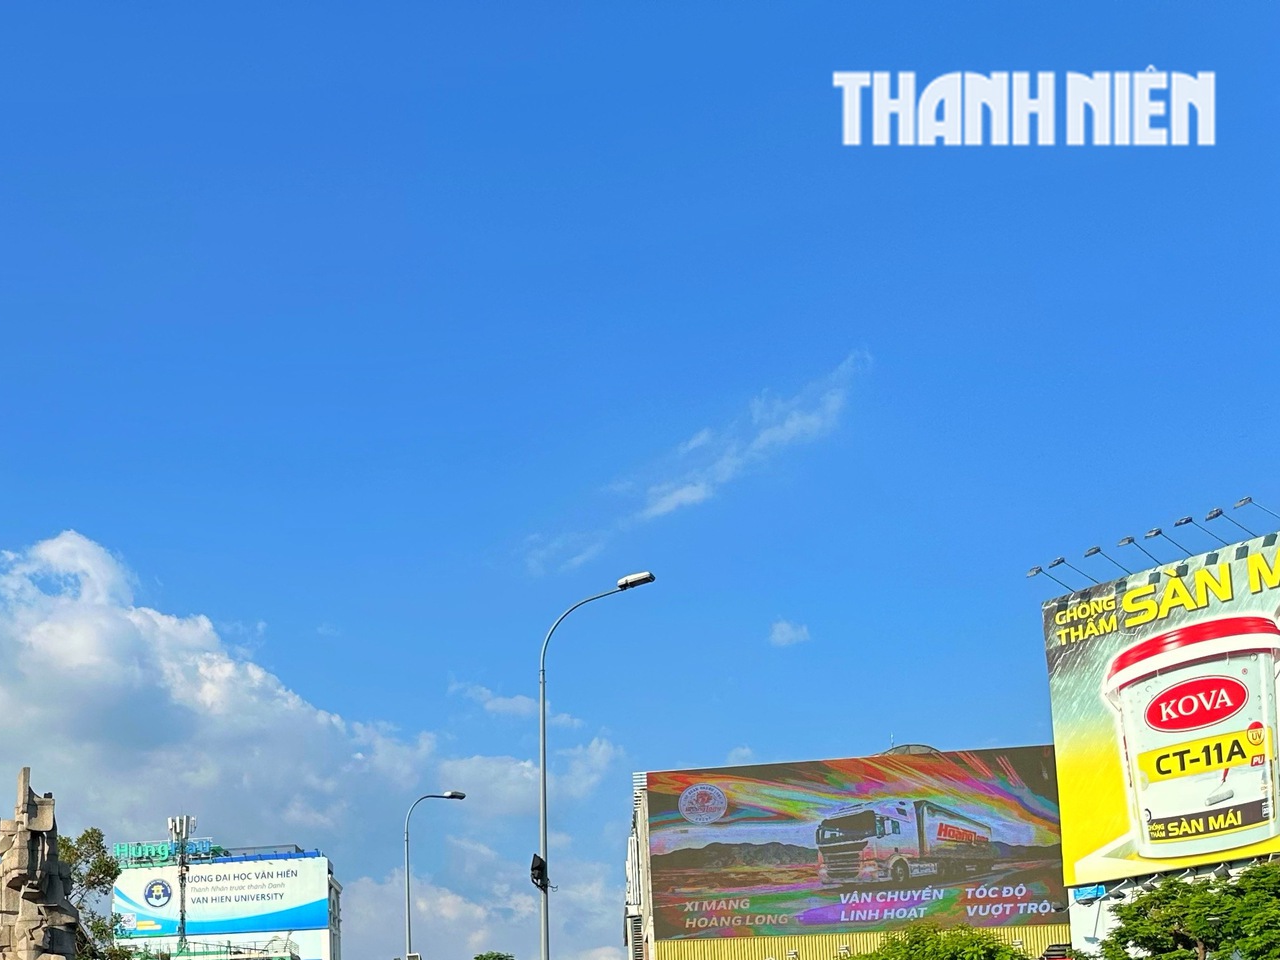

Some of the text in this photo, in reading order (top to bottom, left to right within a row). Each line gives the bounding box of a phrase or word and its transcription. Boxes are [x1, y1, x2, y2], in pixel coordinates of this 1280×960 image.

[1122, 563, 1234, 628] SÀN
[1158, 688, 1234, 722] KOVA
[1155, 739, 1247, 776] CT-11A
[1168, 817, 1205, 838] SÀN
[1209, 808, 1242, 832] MÁI
[234, 892, 285, 902] UNIVERSITY
[839, 891, 873, 905] VẬN
[965, 882, 1027, 899] TỐC ĐỘ
[840, 905, 929, 921] LINH HOẠT
[965, 903, 1016, 917] VƯỢT
[745, 913, 790, 927] LONG
